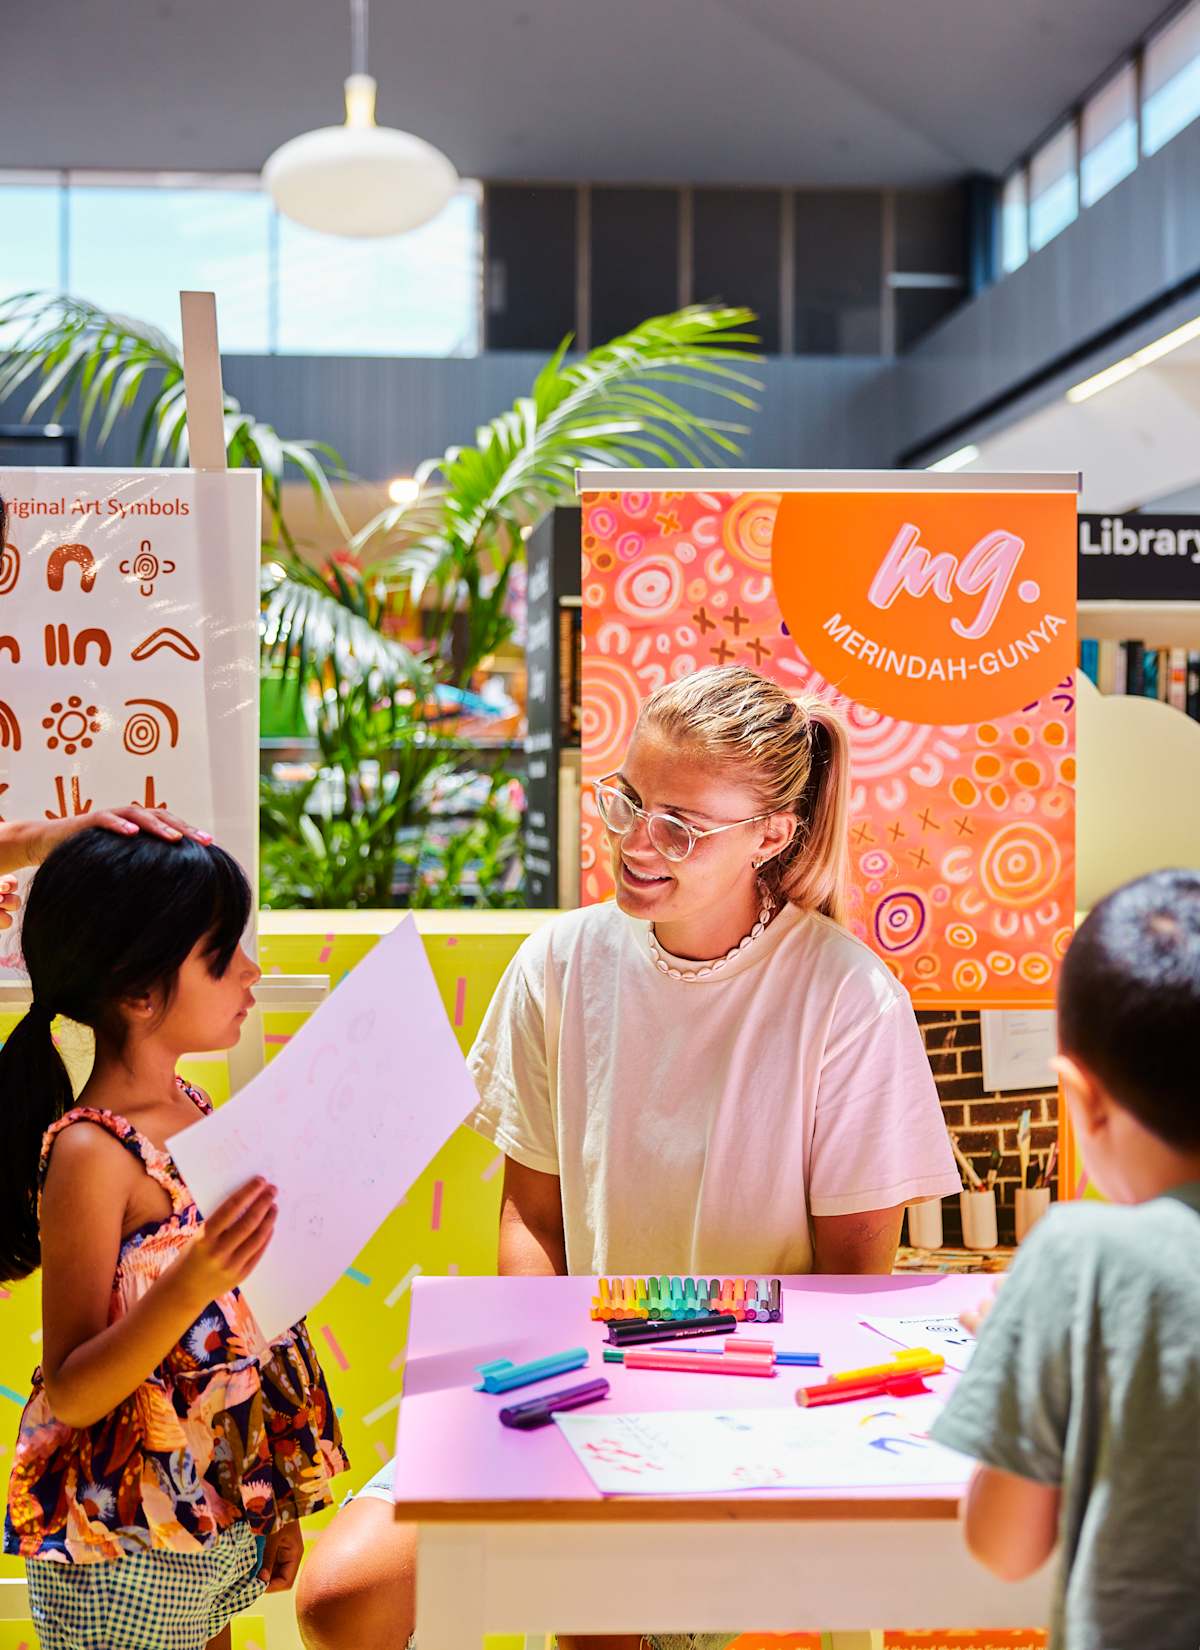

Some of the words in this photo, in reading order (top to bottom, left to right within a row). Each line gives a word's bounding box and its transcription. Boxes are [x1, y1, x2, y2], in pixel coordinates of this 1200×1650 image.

[3, 498, 65, 518] riginal
[71, 499, 101, 515] Art
[107, 498, 190, 519] Symbols
[822, 612, 1067, 681] MERINDAH-GUNYA
